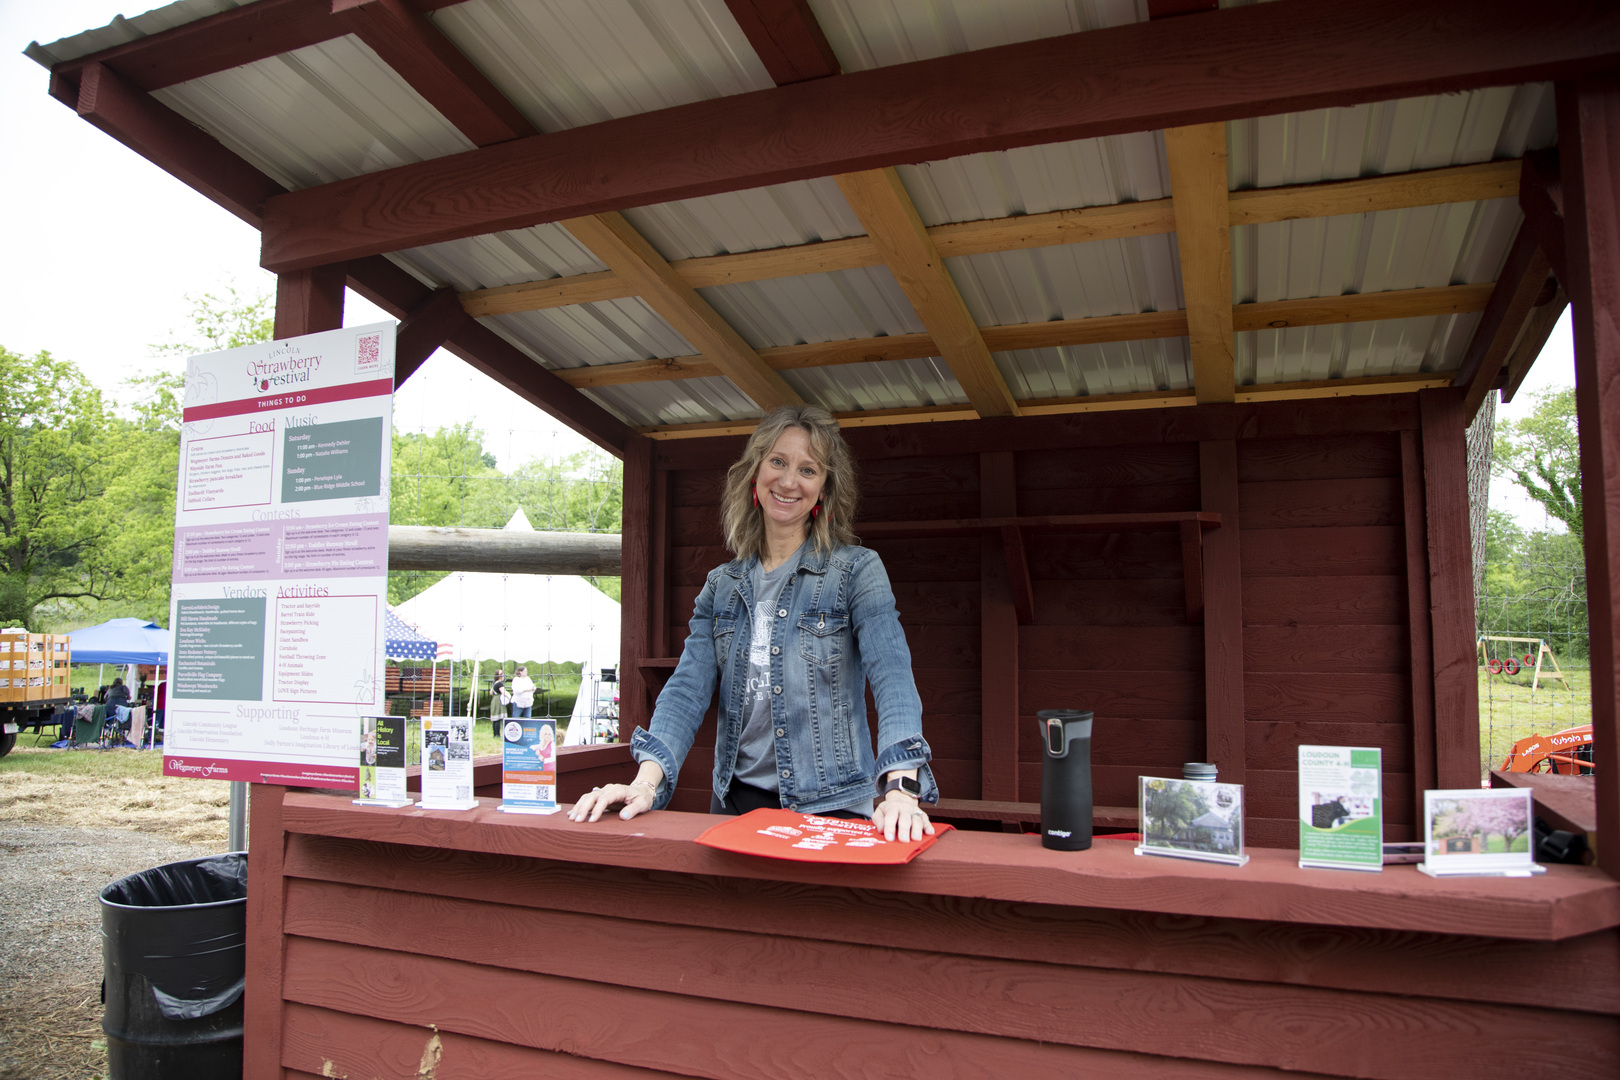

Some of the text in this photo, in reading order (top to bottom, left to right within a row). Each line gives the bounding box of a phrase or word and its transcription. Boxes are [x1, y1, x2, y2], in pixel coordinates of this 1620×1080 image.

[268, 346, 302, 359] LINCOLN
[247, 354, 322, 377] Strawberry
[257, 368, 310, 393] Festival
[258, 394, 306, 408] THINGS TO DO
[249, 418, 275, 434] Food
[285, 413, 318, 428] Music
[288, 434, 311, 442] Saturday
[252, 508, 300, 522] Contests
[223, 585, 267, 599] Vendors
[277, 584, 329, 598] Activities
[236, 704, 300, 723] Supporting
[1551, 734, 1582, 746] Kubota
[168, 759, 228, 776] Wegmeyer Farms
[1048, 830, 1072, 838] contigo
